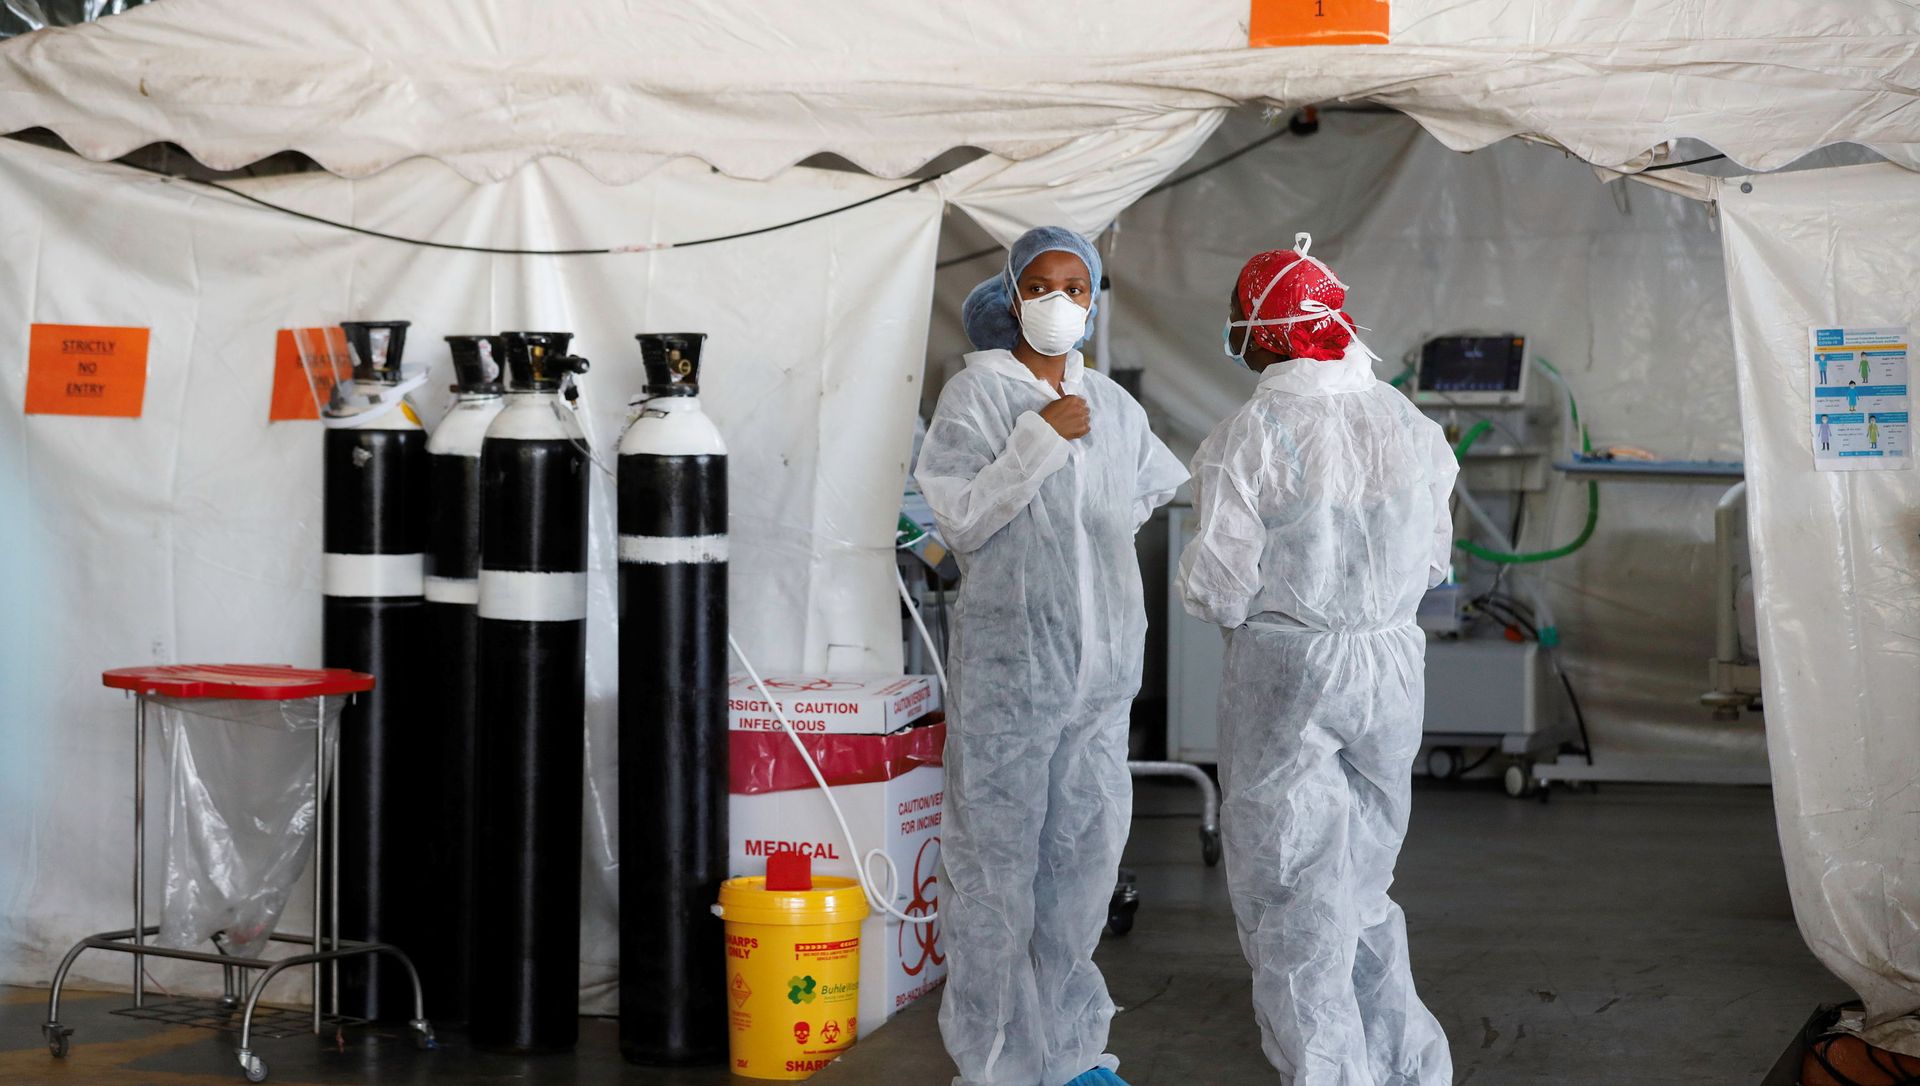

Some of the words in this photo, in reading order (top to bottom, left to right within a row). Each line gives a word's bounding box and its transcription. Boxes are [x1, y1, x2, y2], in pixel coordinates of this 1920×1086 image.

[1315, 0, 1324, 17] 1
[62, 340, 116, 354] STRICTLY
[78, 362, 97, 375] NO
[66, 383, 105, 397] ENTRY
[794, 702, 859, 715] CAUTION
[901, 820, 915, 836] FOR
[745, 840, 839, 860] MEDICAL
